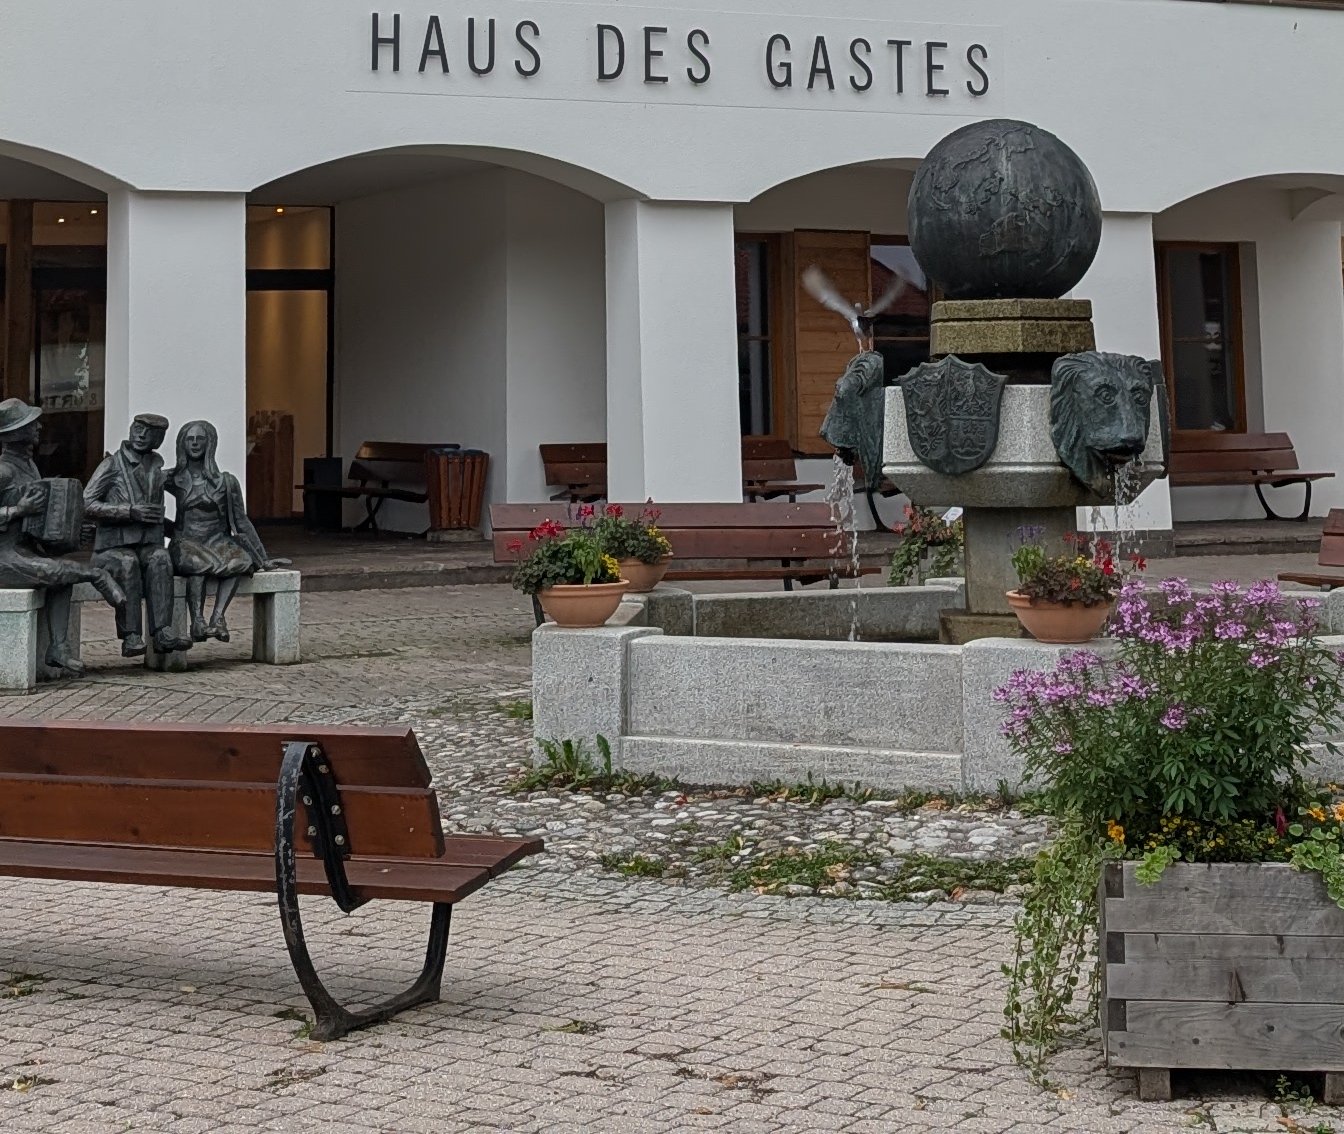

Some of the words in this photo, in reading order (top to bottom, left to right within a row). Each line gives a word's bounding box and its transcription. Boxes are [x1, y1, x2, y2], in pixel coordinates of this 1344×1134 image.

[371, 13, 541, 77] HAUS
[597, 24, 711, 84] DES
[765, 33, 990, 97] GASTES
